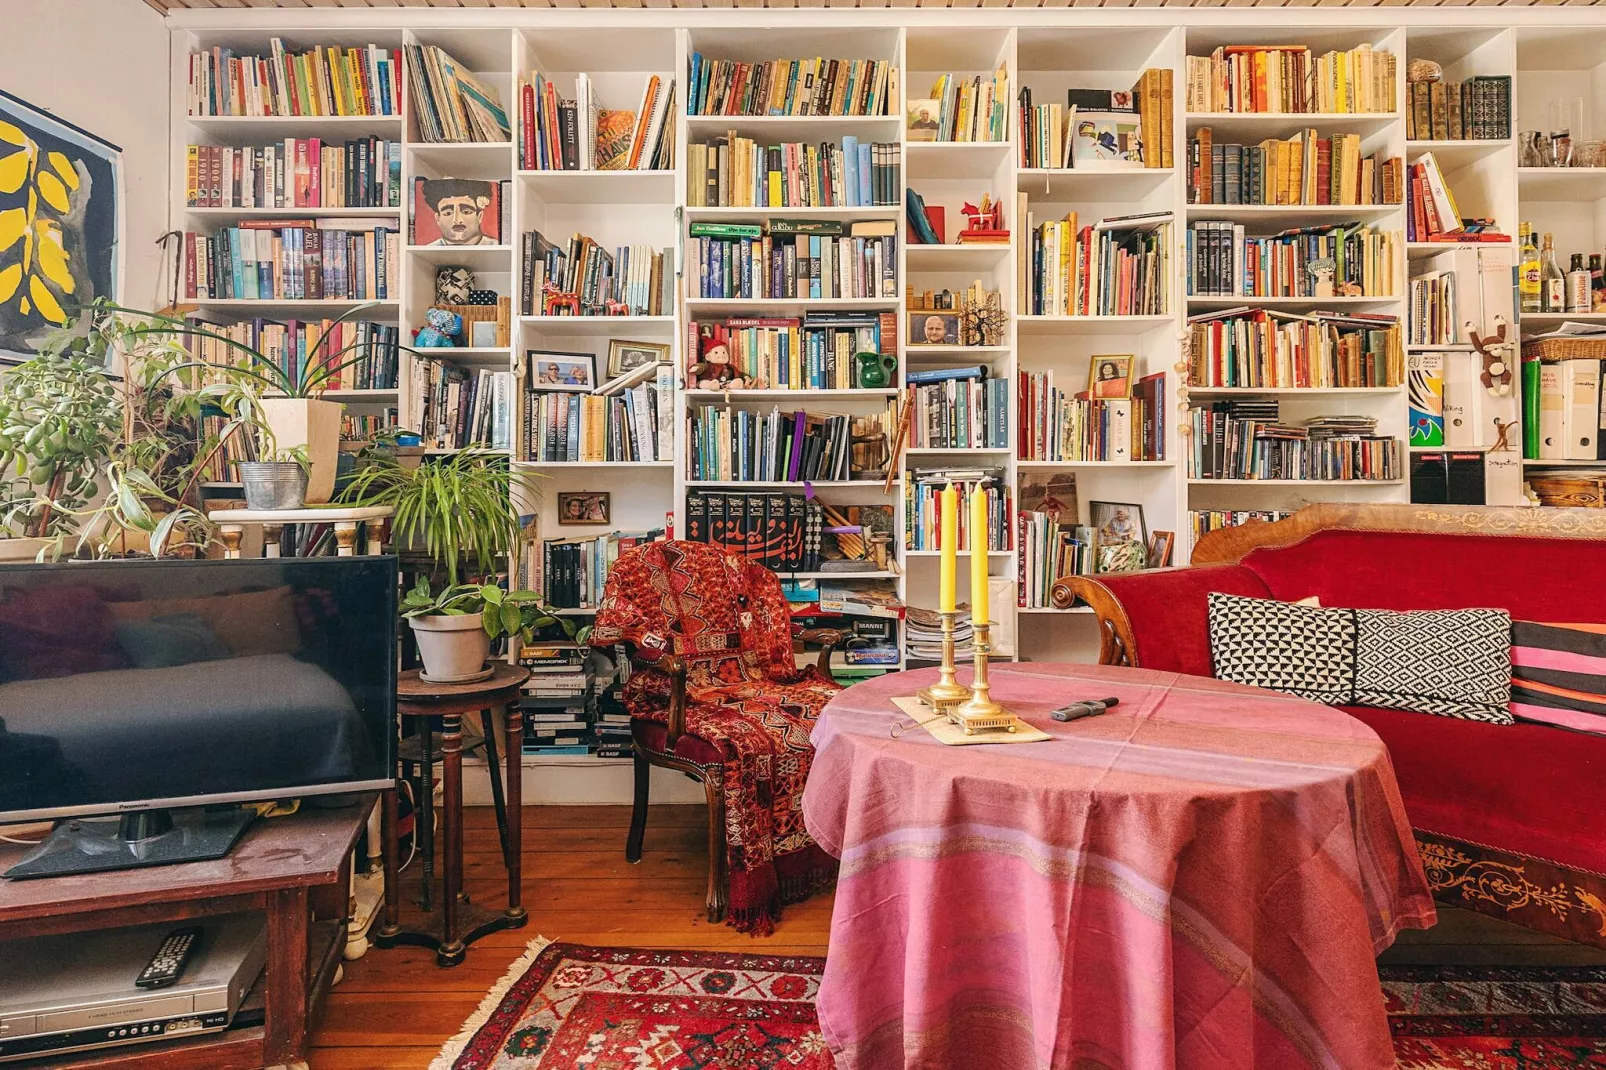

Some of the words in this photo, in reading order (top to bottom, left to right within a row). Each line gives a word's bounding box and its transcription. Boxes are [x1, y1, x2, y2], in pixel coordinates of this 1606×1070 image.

[567, 121, 575, 144] FOLLETT
[198, 157, 207, 182] 1900
[211, 157, 220, 182] 1900
[1576, 275, 1587, 305] Palestine
[638, 421, 647, 450] DRONNING
[118, 802, 151, 810] Panasonic
